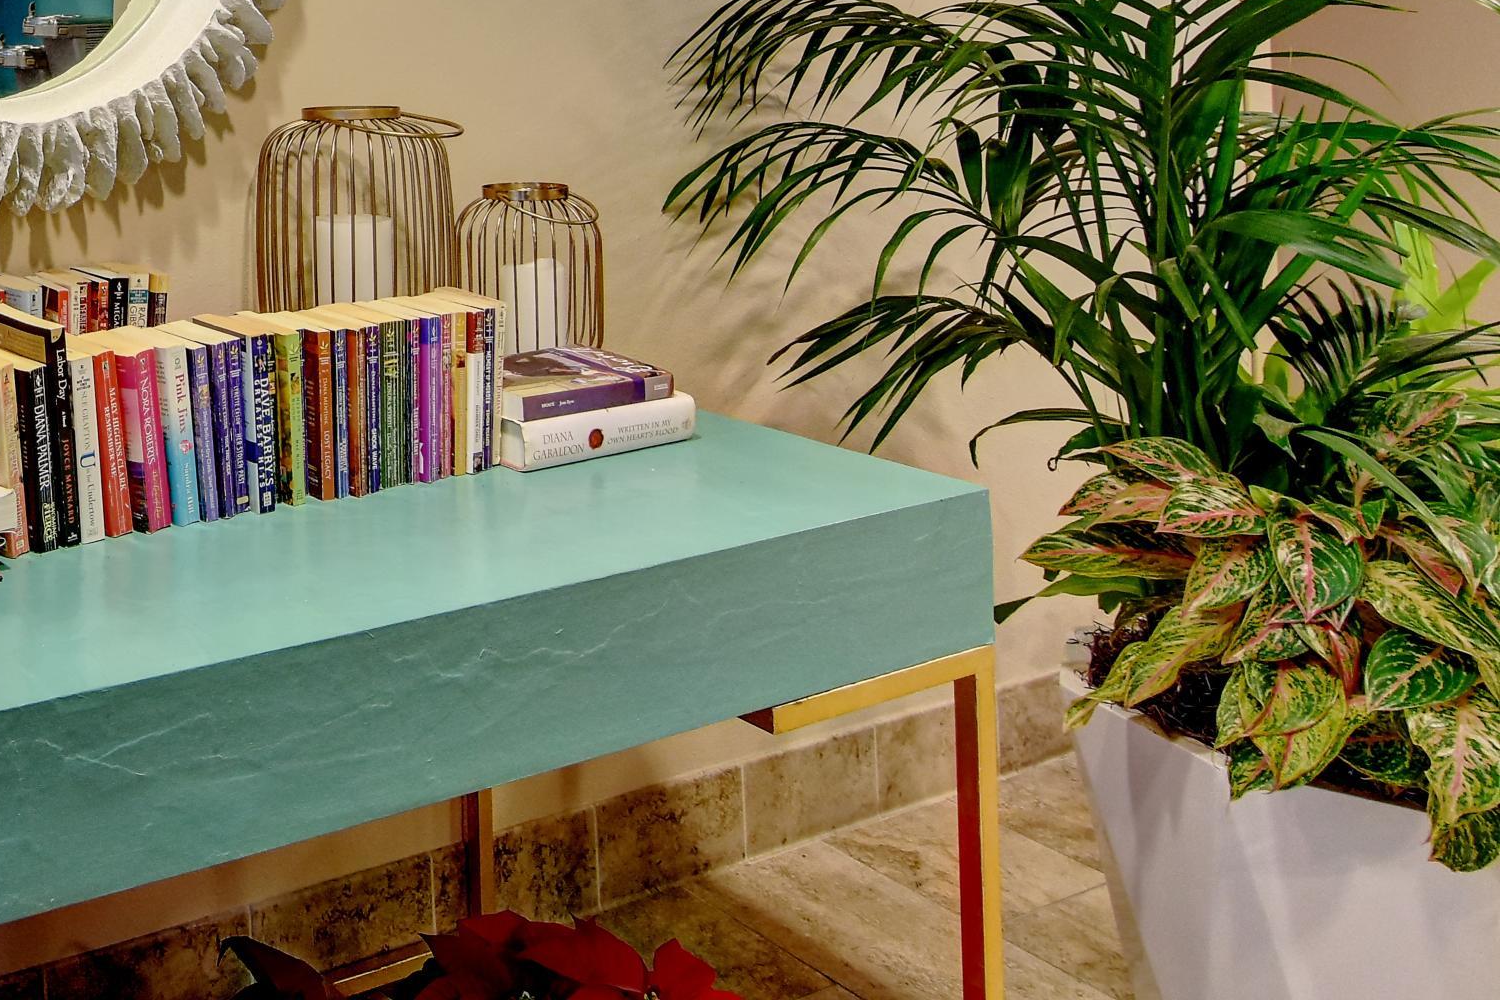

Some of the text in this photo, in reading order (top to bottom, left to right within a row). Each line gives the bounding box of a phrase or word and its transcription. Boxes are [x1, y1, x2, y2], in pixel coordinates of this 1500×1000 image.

[54, 347, 67, 377] Labor
[55, 379, 68, 400] Day
[137, 377, 153, 416] NORA
[173, 373, 187, 403] Pink
[258, 377, 270, 418] DAVE
[32, 403, 47, 440] DIANA
[175, 406, 189, 434] Jinx
[321, 395, 330, 425] MENTINK
[81, 407, 90, 450] GRAFTON
[101, 405, 117, 478] REMEMBER ME
[107, 386, 127, 491] MARY HIGGINS CLARK
[140, 416, 158, 465] ROBERTS
[253, 378, 265, 488] GREATEST HITS
[322, 429, 331, 449] LOST
[532, 443, 585, 461] GABALDON
[607, 435, 626, 445] OWN
[654, 426, 679, 438] BLOOD
[542, 418, 672, 445] DIANA WRITTEN IN MY
[35, 443, 51, 491] PALMER
[60, 438, 72, 471] JOYCE
[78, 449, 96, 468] U
[260, 423, 274, 487] BARRY'S
[322, 450, 332, 480] LEGACY
[236, 469, 245, 485] PAST
[63, 473, 75, 524] MAYNARD
[86, 483, 97, 527] Undertow
